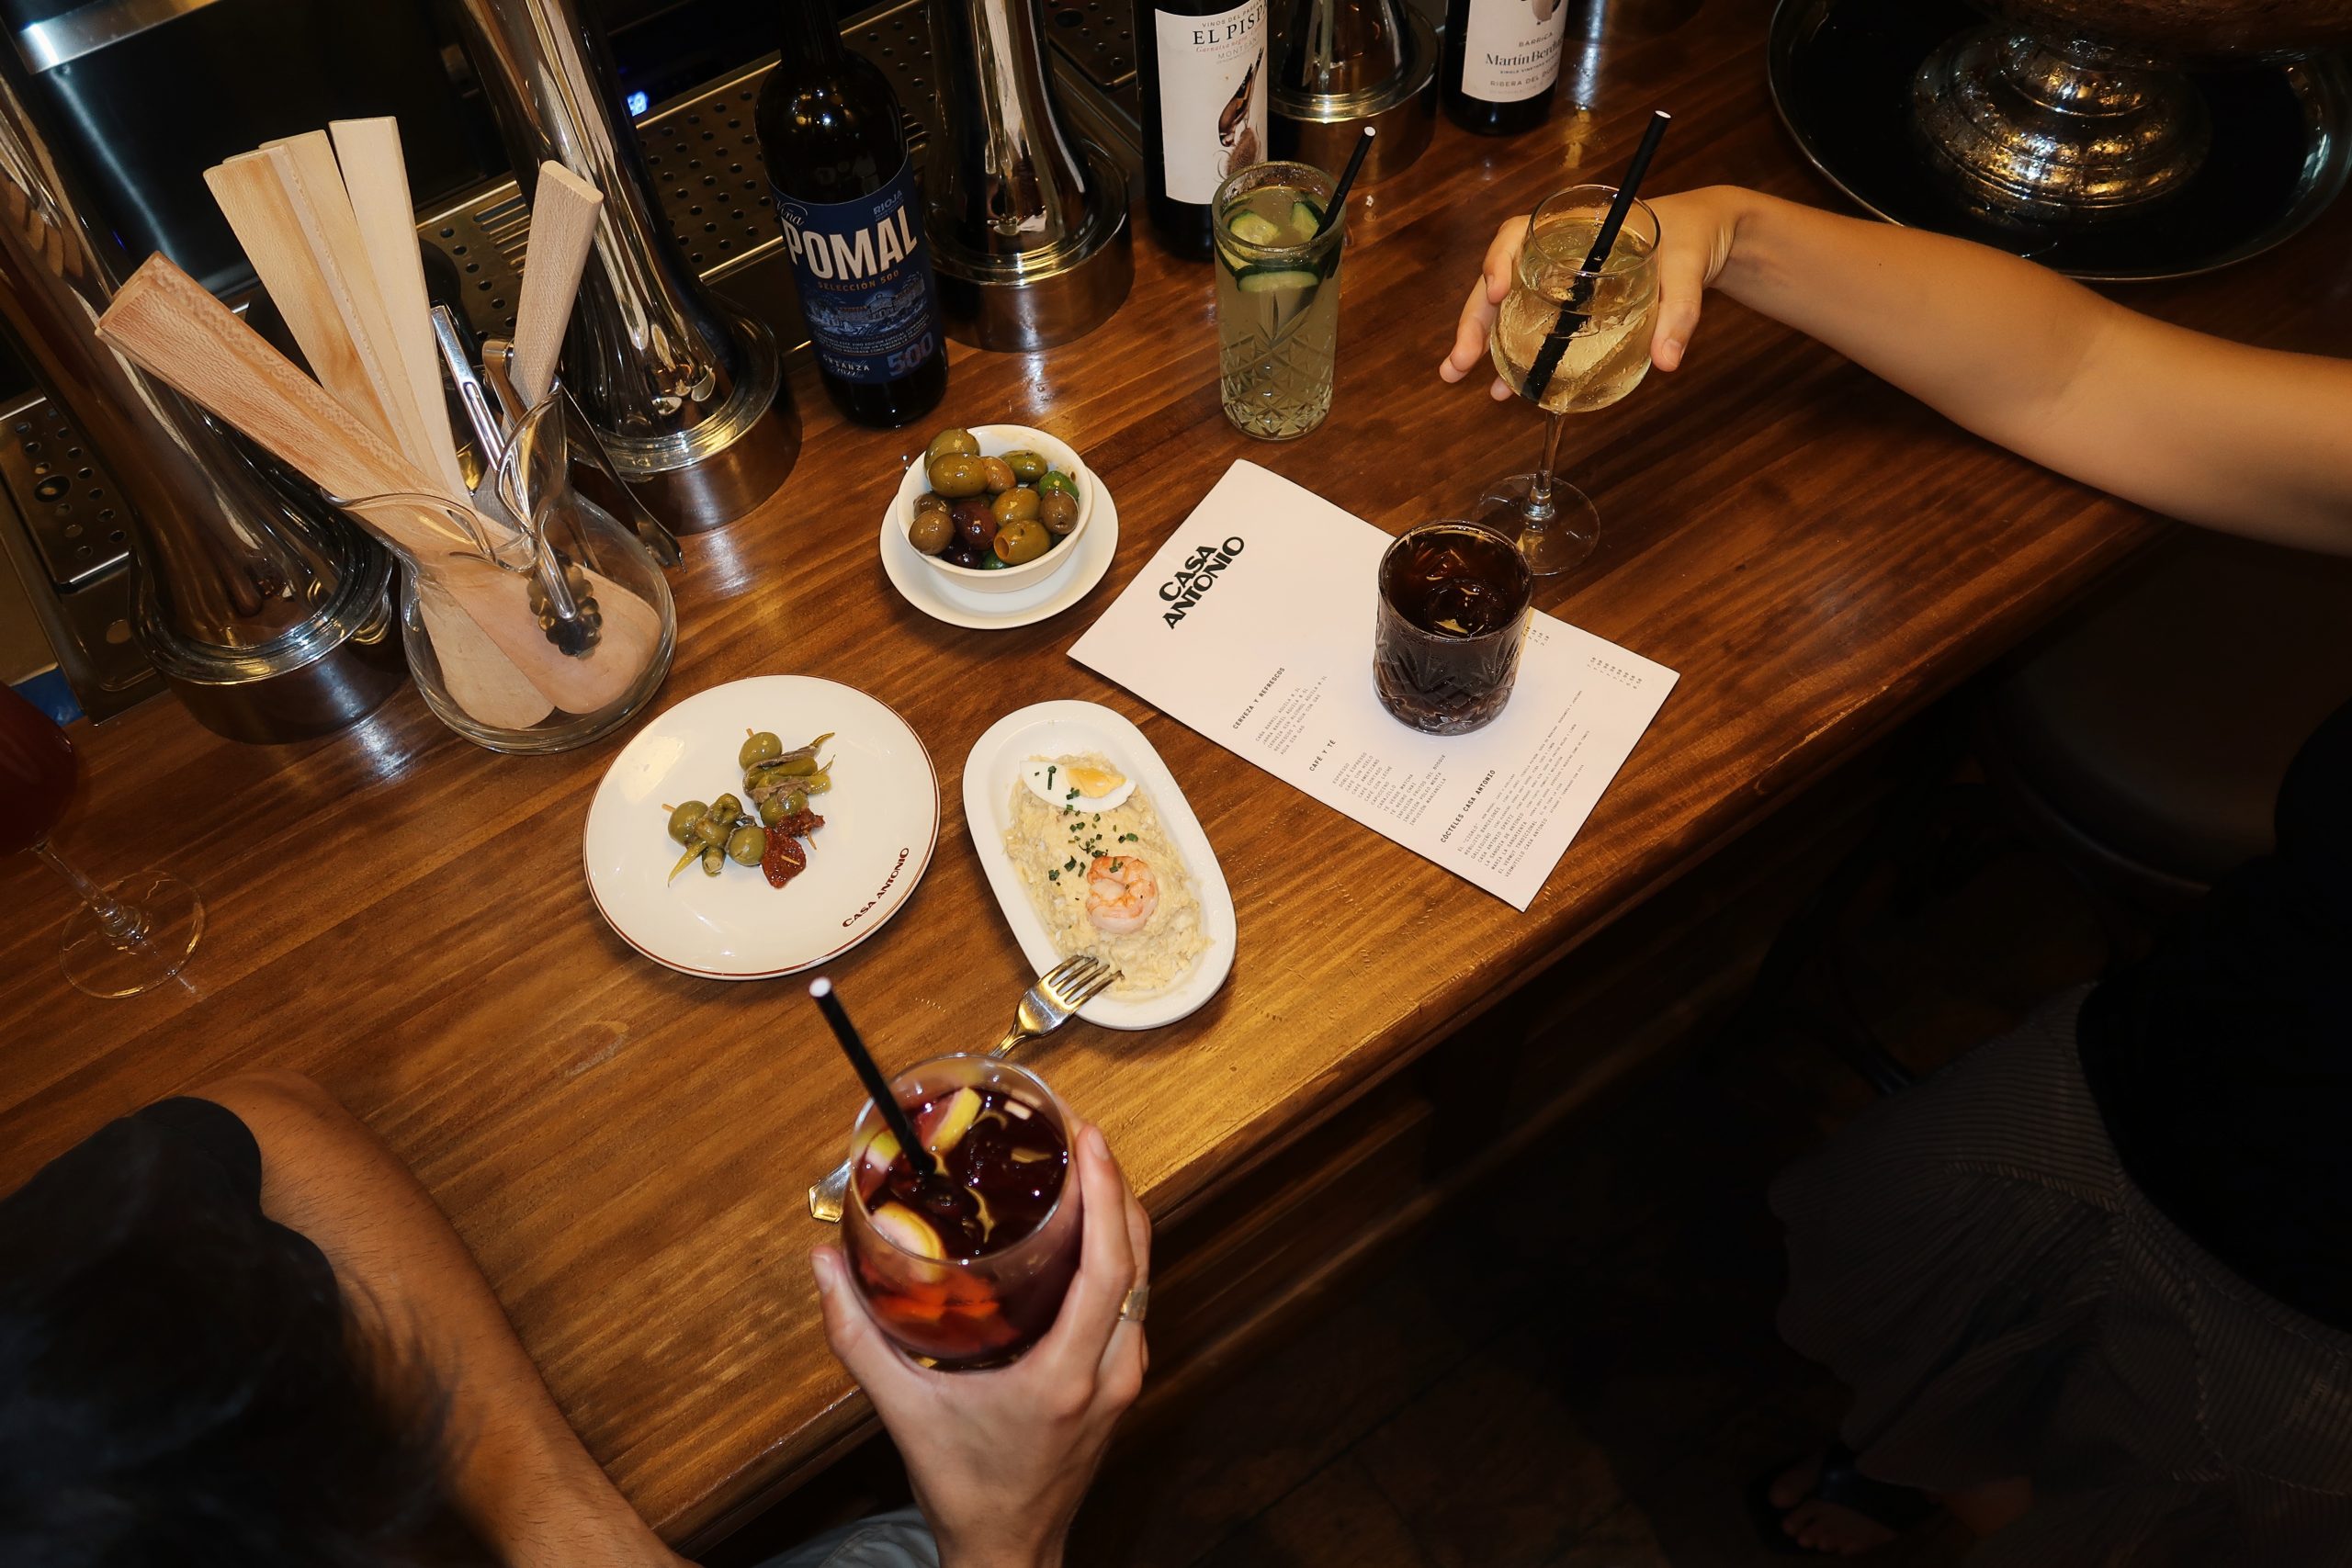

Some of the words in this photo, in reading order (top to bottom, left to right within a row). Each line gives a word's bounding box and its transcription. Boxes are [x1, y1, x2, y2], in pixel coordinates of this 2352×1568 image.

[1193, 29, 1220, 45] EL
[1202, 19, 1226, 28] VINOS
[873, 189, 902, 215] RIOJA
[781, 205, 917, 280] POMAL
[818, 279, 876, 291] SELECCIÓN
[879, 269, 899, 284] 500
[887, 332, 933, 377] 500
[1159, 546, 1218, 602] CASA
[1162, 536, 1245, 630] ANTONIO
[1232, 705, 1254, 728] CERVEZA
[1258, 667, 1285, 697] REFRESCOS
[1440, 813, 1464, 842] CÓCTELES
[1463, 796, 1476, 811] CASA
[1475, 770, 1495, 795] ANTONIO
[842, 901, 876, 927] CASA
[876, 848, 909, 899] ANTONIO
